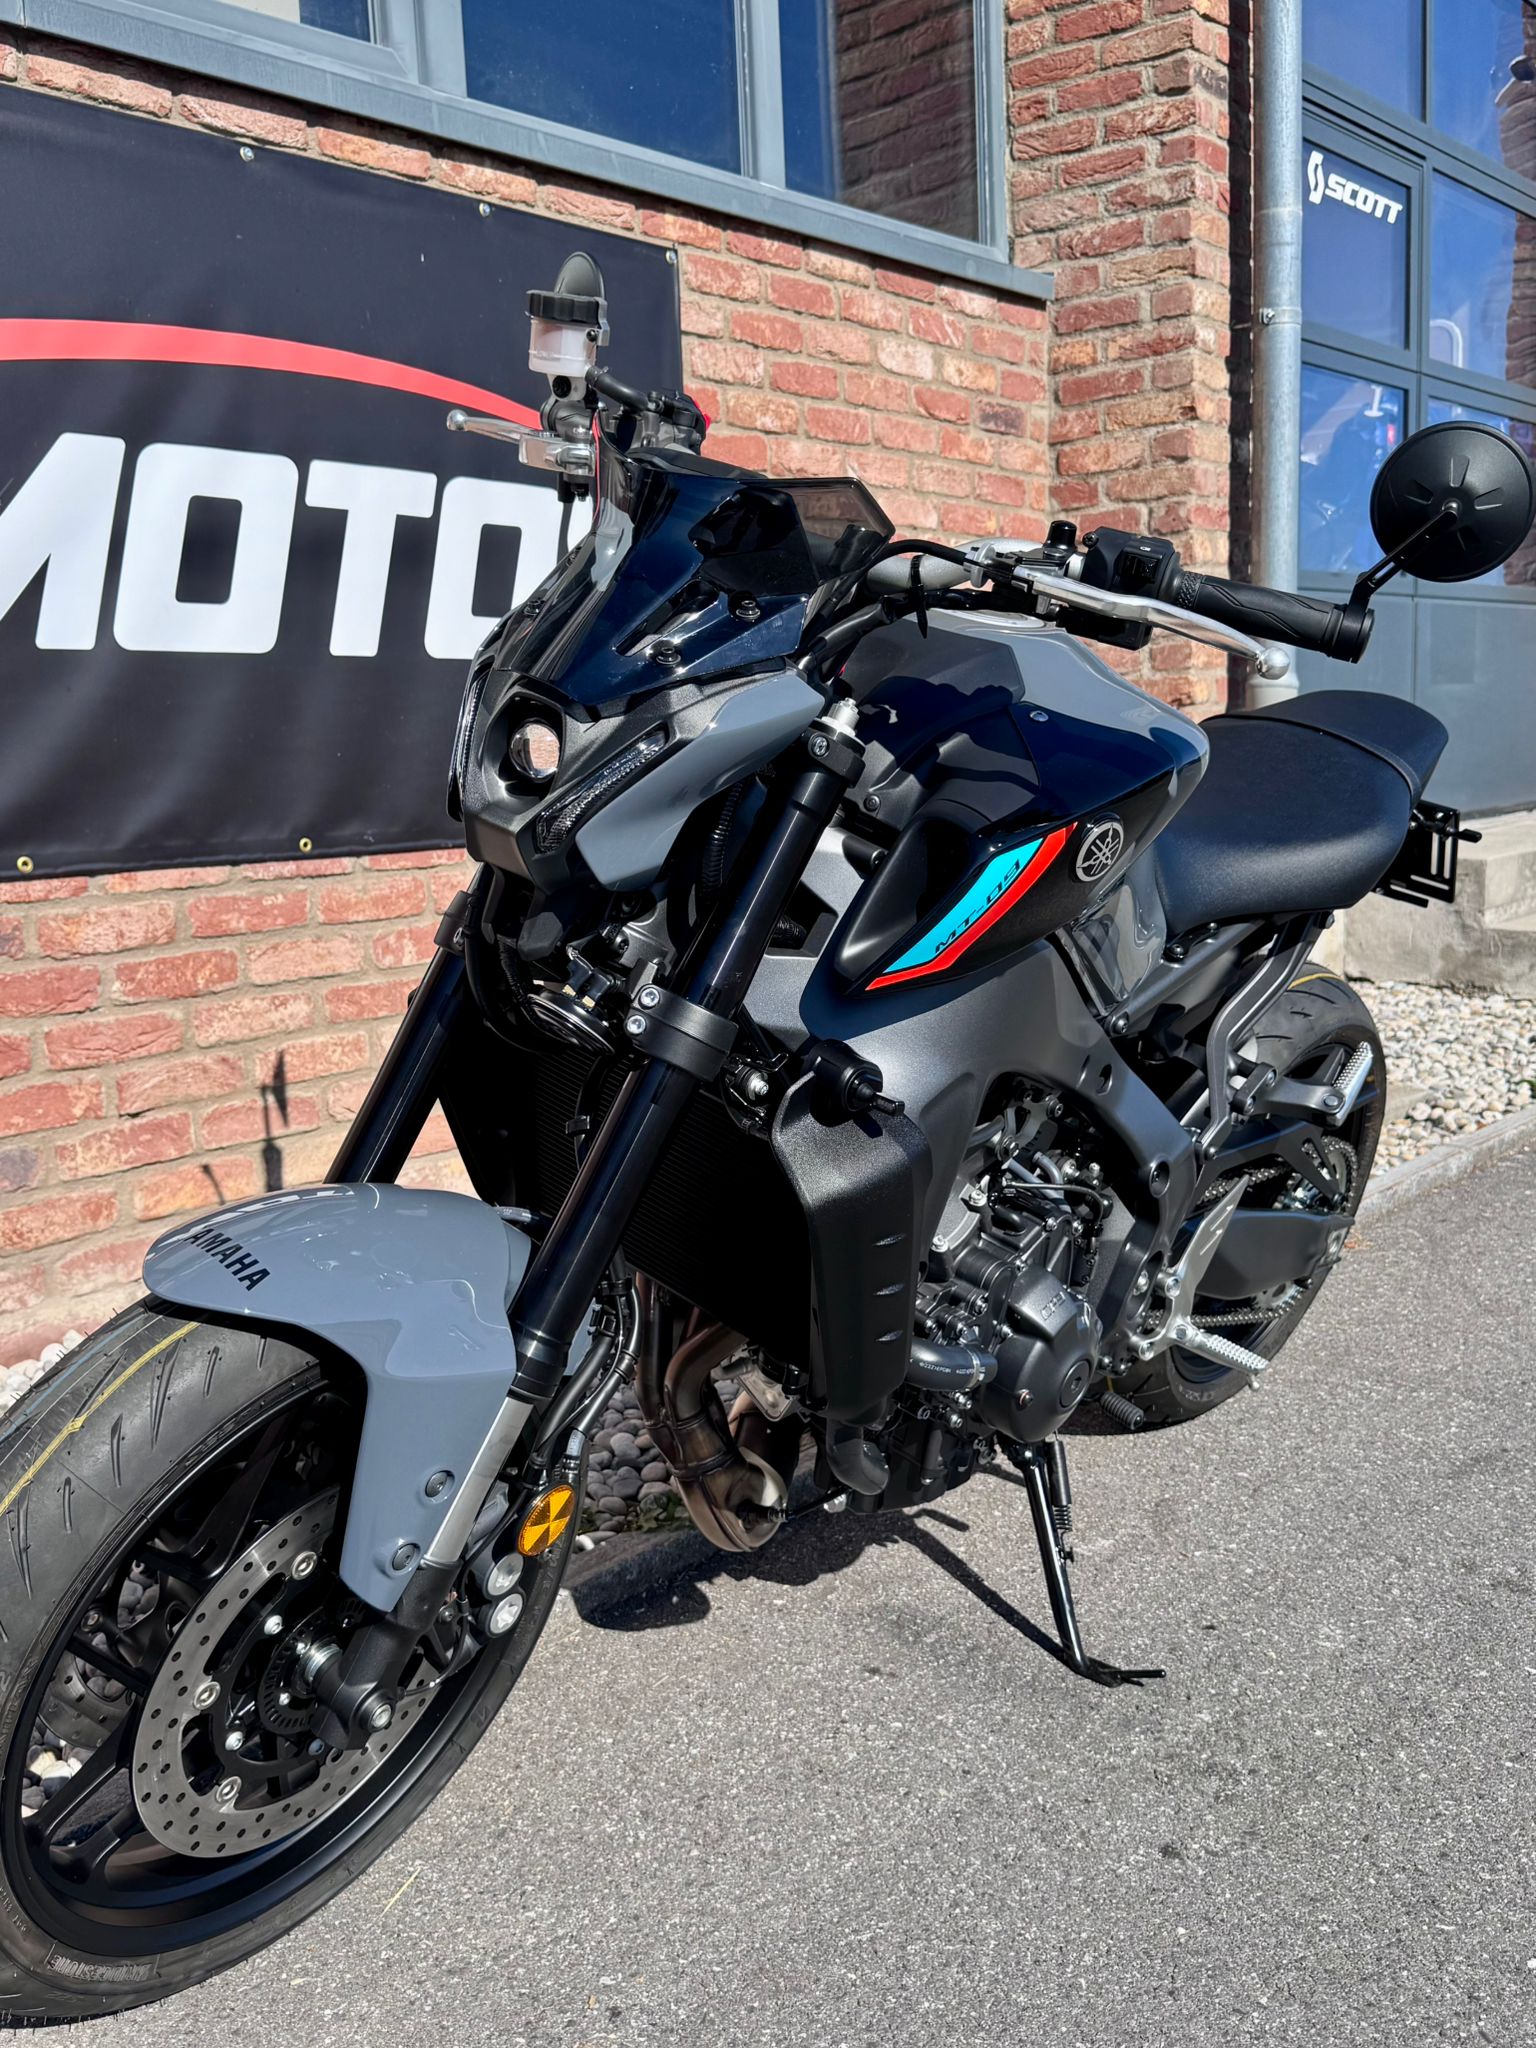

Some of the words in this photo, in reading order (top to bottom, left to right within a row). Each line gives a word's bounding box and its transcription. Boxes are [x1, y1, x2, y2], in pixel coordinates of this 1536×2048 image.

[1325, 173, 1403, 225] SCOTT
[0, 431, 594, 661] OTO
[934, 859, 1020, 954] MT-09
[184, 1228, 270, 1292] AMAHA
